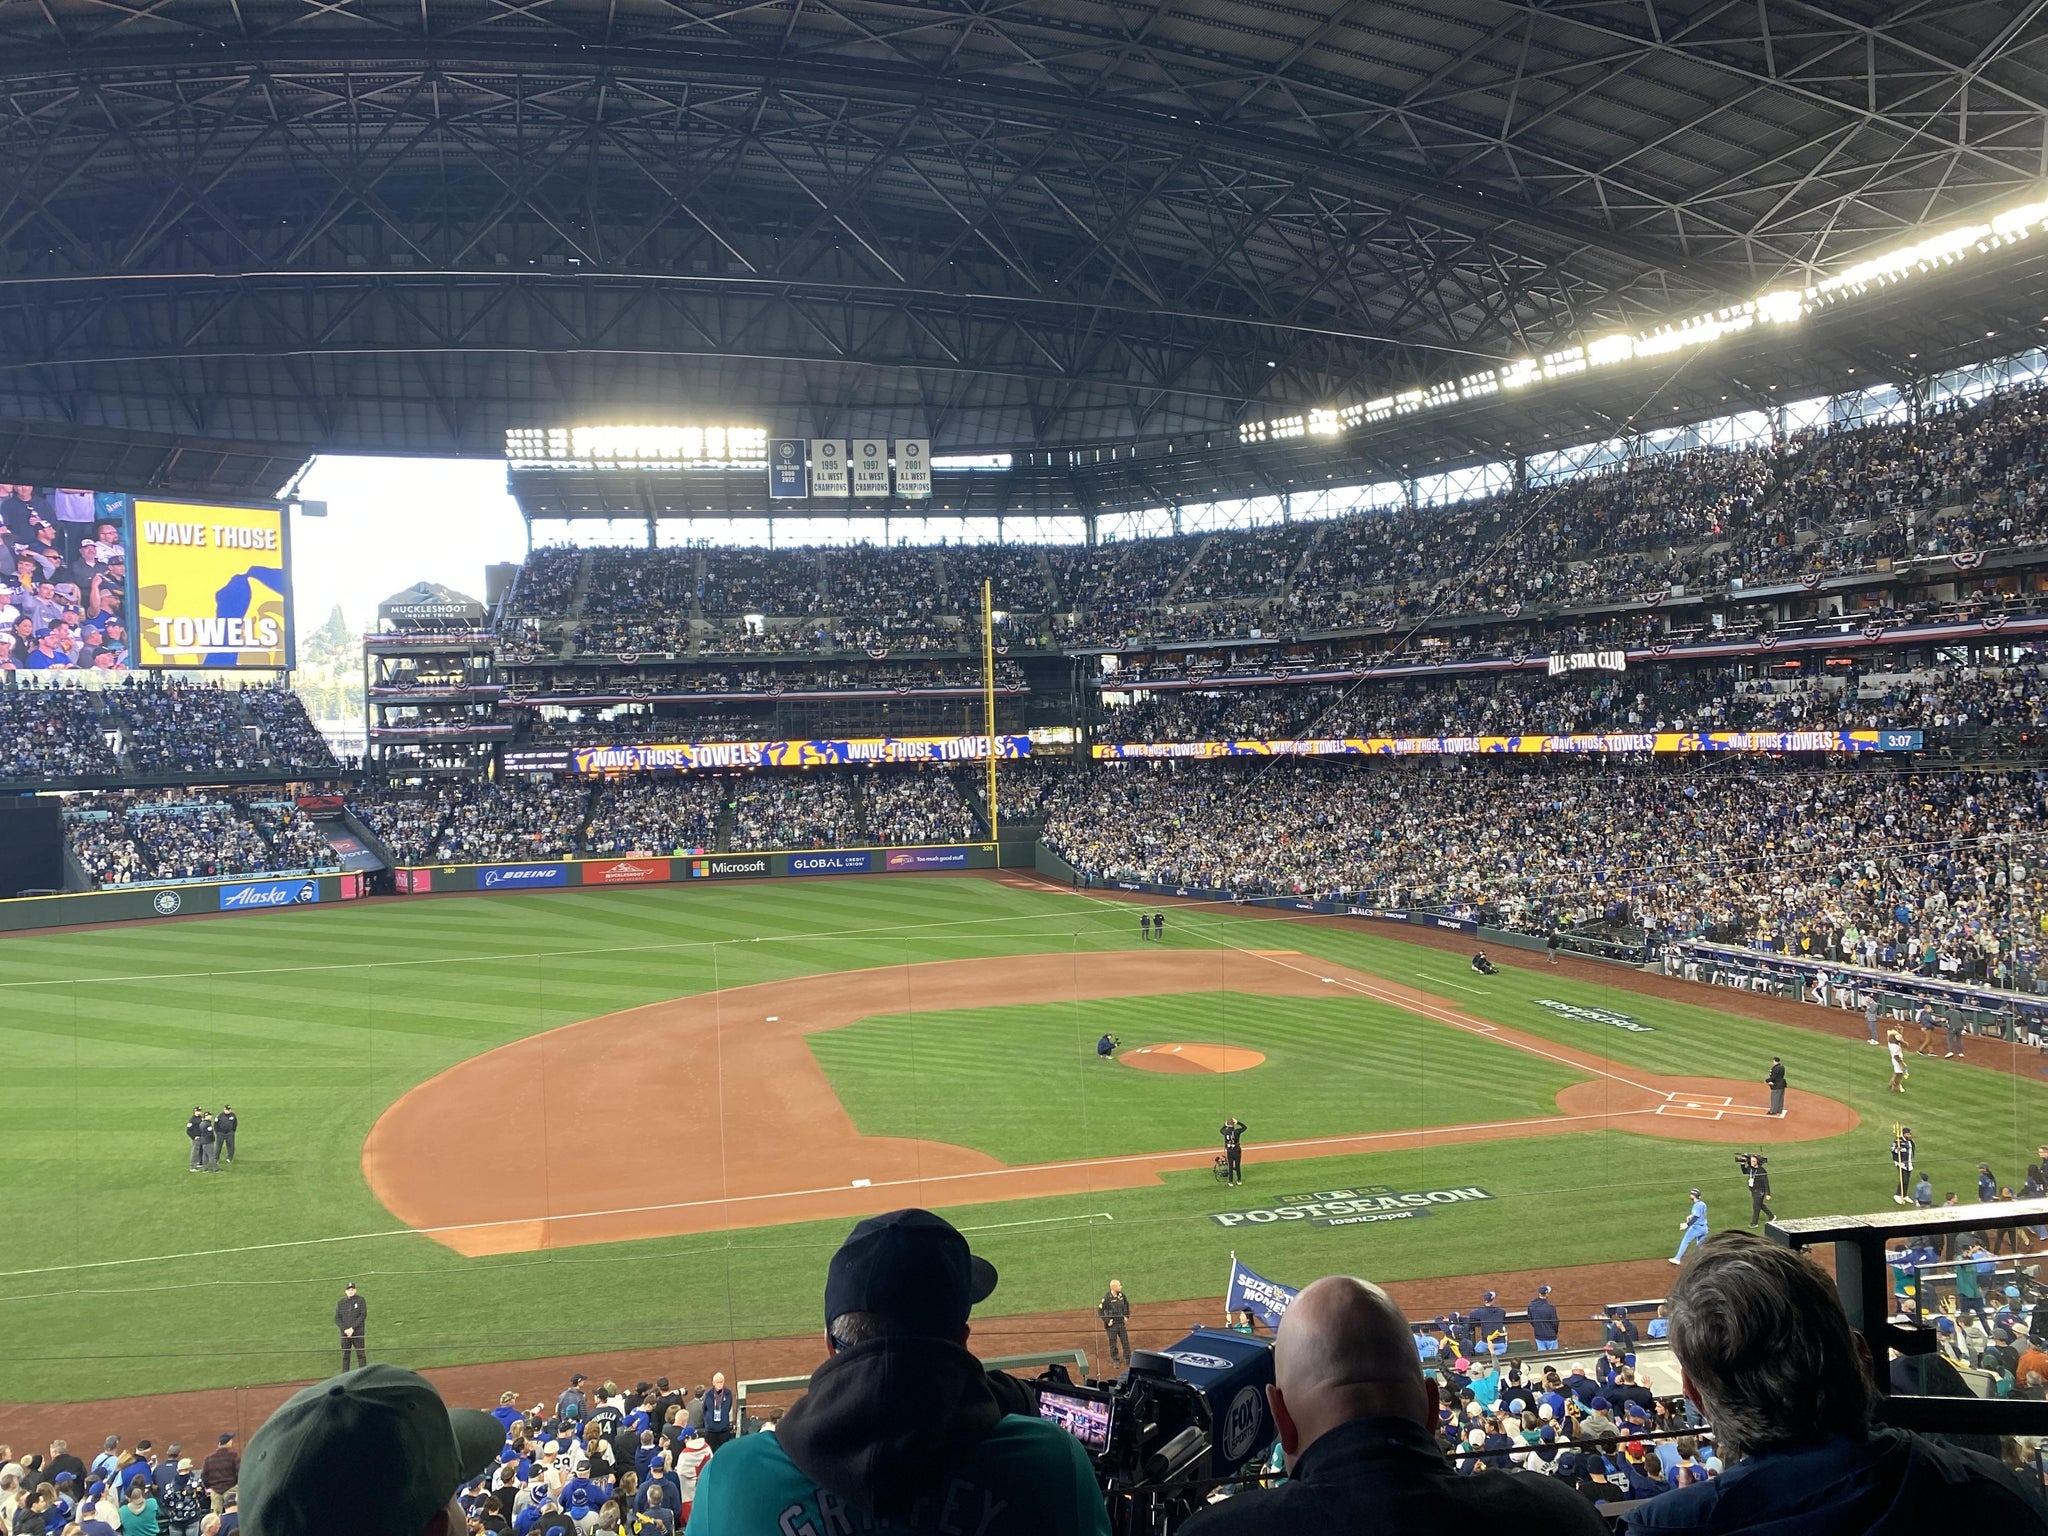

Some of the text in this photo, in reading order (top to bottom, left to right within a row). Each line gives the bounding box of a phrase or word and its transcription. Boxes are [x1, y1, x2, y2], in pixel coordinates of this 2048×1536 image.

[822, 460, 838, 470] 1995
[863, 460, 879, 470] 1997
[905, 460, 921, 470] 2001
[817, 472, 843, 480] A.L. WEST
[858, 472, 884, 480] A.L. WEST
[900, 472, 926, 480] A.L. WEST
[814, 483, 847, 491] CHAMPIONS
[856, 483, 888, 491] CHAMPIONS
[898, 483, 930, 491] CHAMPIONS
[143, 520, 278, 550] WAVE THOSE
[391, 605, 467, 613] MUCKLESHOOT
[153, 616, 278, 647] TOWELS
[1570, 653, 1596, 670] STAR
[1598, 650, 1626, 671] CLUB
[1272, 740, 1347, 753] WAVE THOSE TOWELS
[1396, 737, 1480, 751] WAVE THOSE TOWELS
[1550, 735, 1653, 751] WAVE THOSE TOWELS
[1728, 731, 1833, 749] WAVE THOSE TOWELS
[1889, 735, 1912, 747] 3:07
[593, 744, 761, 767] WAVE THOSE TOWELS
[848, 743, 886, 759] WAVE
[889, 742, 932, 758] THOSE
[1123, 742, 1206, 757] WAVE THOSE TOWELS
[712, 860, 765, 874] Microsoft
[794, 858, 843, 869] GLOBAL
[503, 869, 556, 879] BOEING
[225, 886, 288, 906] Alaska
[1358, 908, 1374, 916] ALCS
[1534, 999, 1655, 1032] POSTSEASON
[1215, 1187, 1492, 1227] POSTSEASON
[1328, 1210, 1413, 1226] loanDepot
[1237, 1274, 1274, 1297] SEIZE
[1180, 1353, 1219, 1365] FOX
[1232, 1397, 1253, 1438] FOX
[599, 1421, 612, 1434] 14
[1231, 1424, 1254, 1449] SPORTS
